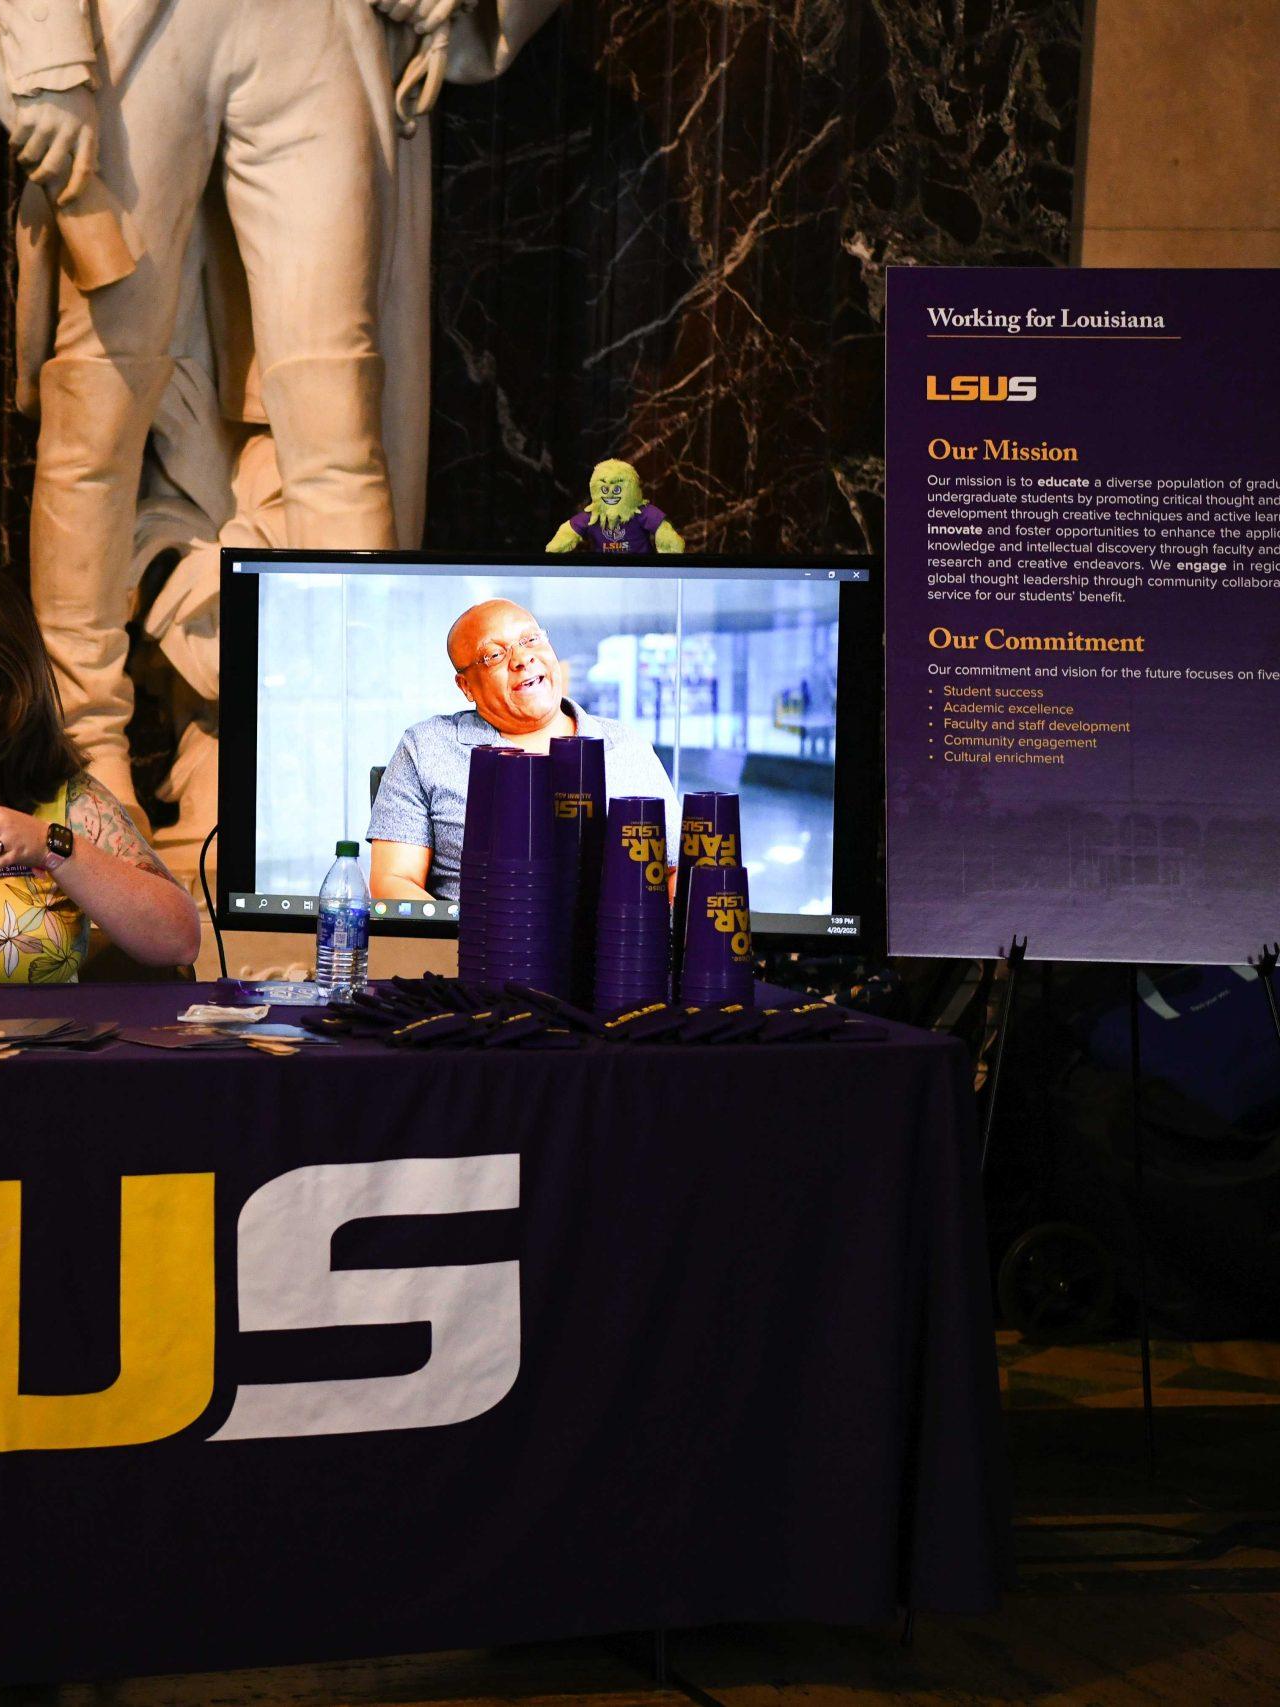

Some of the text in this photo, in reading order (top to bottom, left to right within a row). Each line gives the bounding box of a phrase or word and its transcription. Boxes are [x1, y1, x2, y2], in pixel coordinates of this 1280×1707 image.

[926, 307, 1166, 334] Working for Louisiana
[926, 375, 1037, 402] LSUS
[928, 438, 1079, 462] Our Mission
[927, 474, 951, 486] Our
[955, 475, 1002, 487] mission
[1006, 475, 1016, 487] is
[1020, 476, 1033, 487] to
[1037, 476, 1090, 488] educate
[1094, 479, 1102, 488] a
[1106, 477, 1152, 488] diverse
[1157, 477, 1224, 491] population
[1229, 477, 1242, 489] of
[927, 491, 1018, 505] undergraduate
[1021, 492, 1074, 504] students
[1077, 493, 1093, 507] by
[1096, 493, 1159, 507] promoting
[1162, 494, 1202, 505] critical
[1205, 494, 1255, 508] thought
[927, 507, 1008, 521] development
[1010, 508, 1059, 523] through
[1062, 509, 1112, 521] creative
[1114, 510, 1183, 523] techniques
[1186, 510, 1210, 522] and
[1213, 511, 1251, 522] active
[927, 523, 983, 535] innovate
[987, 524, 1011, 536] and
[1015, 524, 1051, 536] foster
[1055, 525, 1139, 539] opportunities
[1143, 527, 1156, 538] to
[1160, 526, 1216, 538] enhance
[1220, 527, 1241, 539] the
[927, 539, 996, 554] knowledge
[999, 540, 1022, 552] and
[1026, 541, 1093, 553] intellectual
[1096, 542, 1156, 556] discovery
[1160, 542, 1208, 557] through
[1212, 543, 1254, 557] faculty
[927, 556, 982, 568] research
[988, 557, 1012, 569] and
[1017, 558, 1068, 569] creative
[1073, 558, 1144, 570] endeavors.
[1150, 559, 1171, 571] We
[1176, 562, 1227, 574] engage
[1232, 560, 1244, 571] in
[927, 572, 966, 586] global
[970, 573, 1019, 587] thought
[1023, 573, 1089, 588] leadership
[1093, 574, 1143, 589] through
[1147, 576, 1218, 590] community
[927, 589, 1126, 603] service for our students' benefit.
[928, 626, 1145, 652] Our Commitment
[928, 663, 952, 675] Our
[954, 664, 1031, 676] commitment
[1034, 665, 1058, 677] and
[1061, 666, 1097, 678] vision
[1100, 666, 1118, 678] for
[1121, 667, 1142, 679] the
[1145, 667, 1182, 679] future
[1185, 667, 1234, 680] focuses
[1237, 671, 1254, 680] on
[943, 685, 1044, 698] Student success
[943, 701, 1074, 715] Academic excellence
[944, 718, 1130, 734] Faculty and staff development
[944, 734, 1097, 750] Community engagement
[944, 750, 1064, 764] Cultural enrichment
[622, 825, 660, 837] LSUS
[622, 838, 666, 862] AR.
[707, 896, 744, 908] LSUS
[707, 909, 750, 933] AR.
[844, 917, 854, 925] PM
